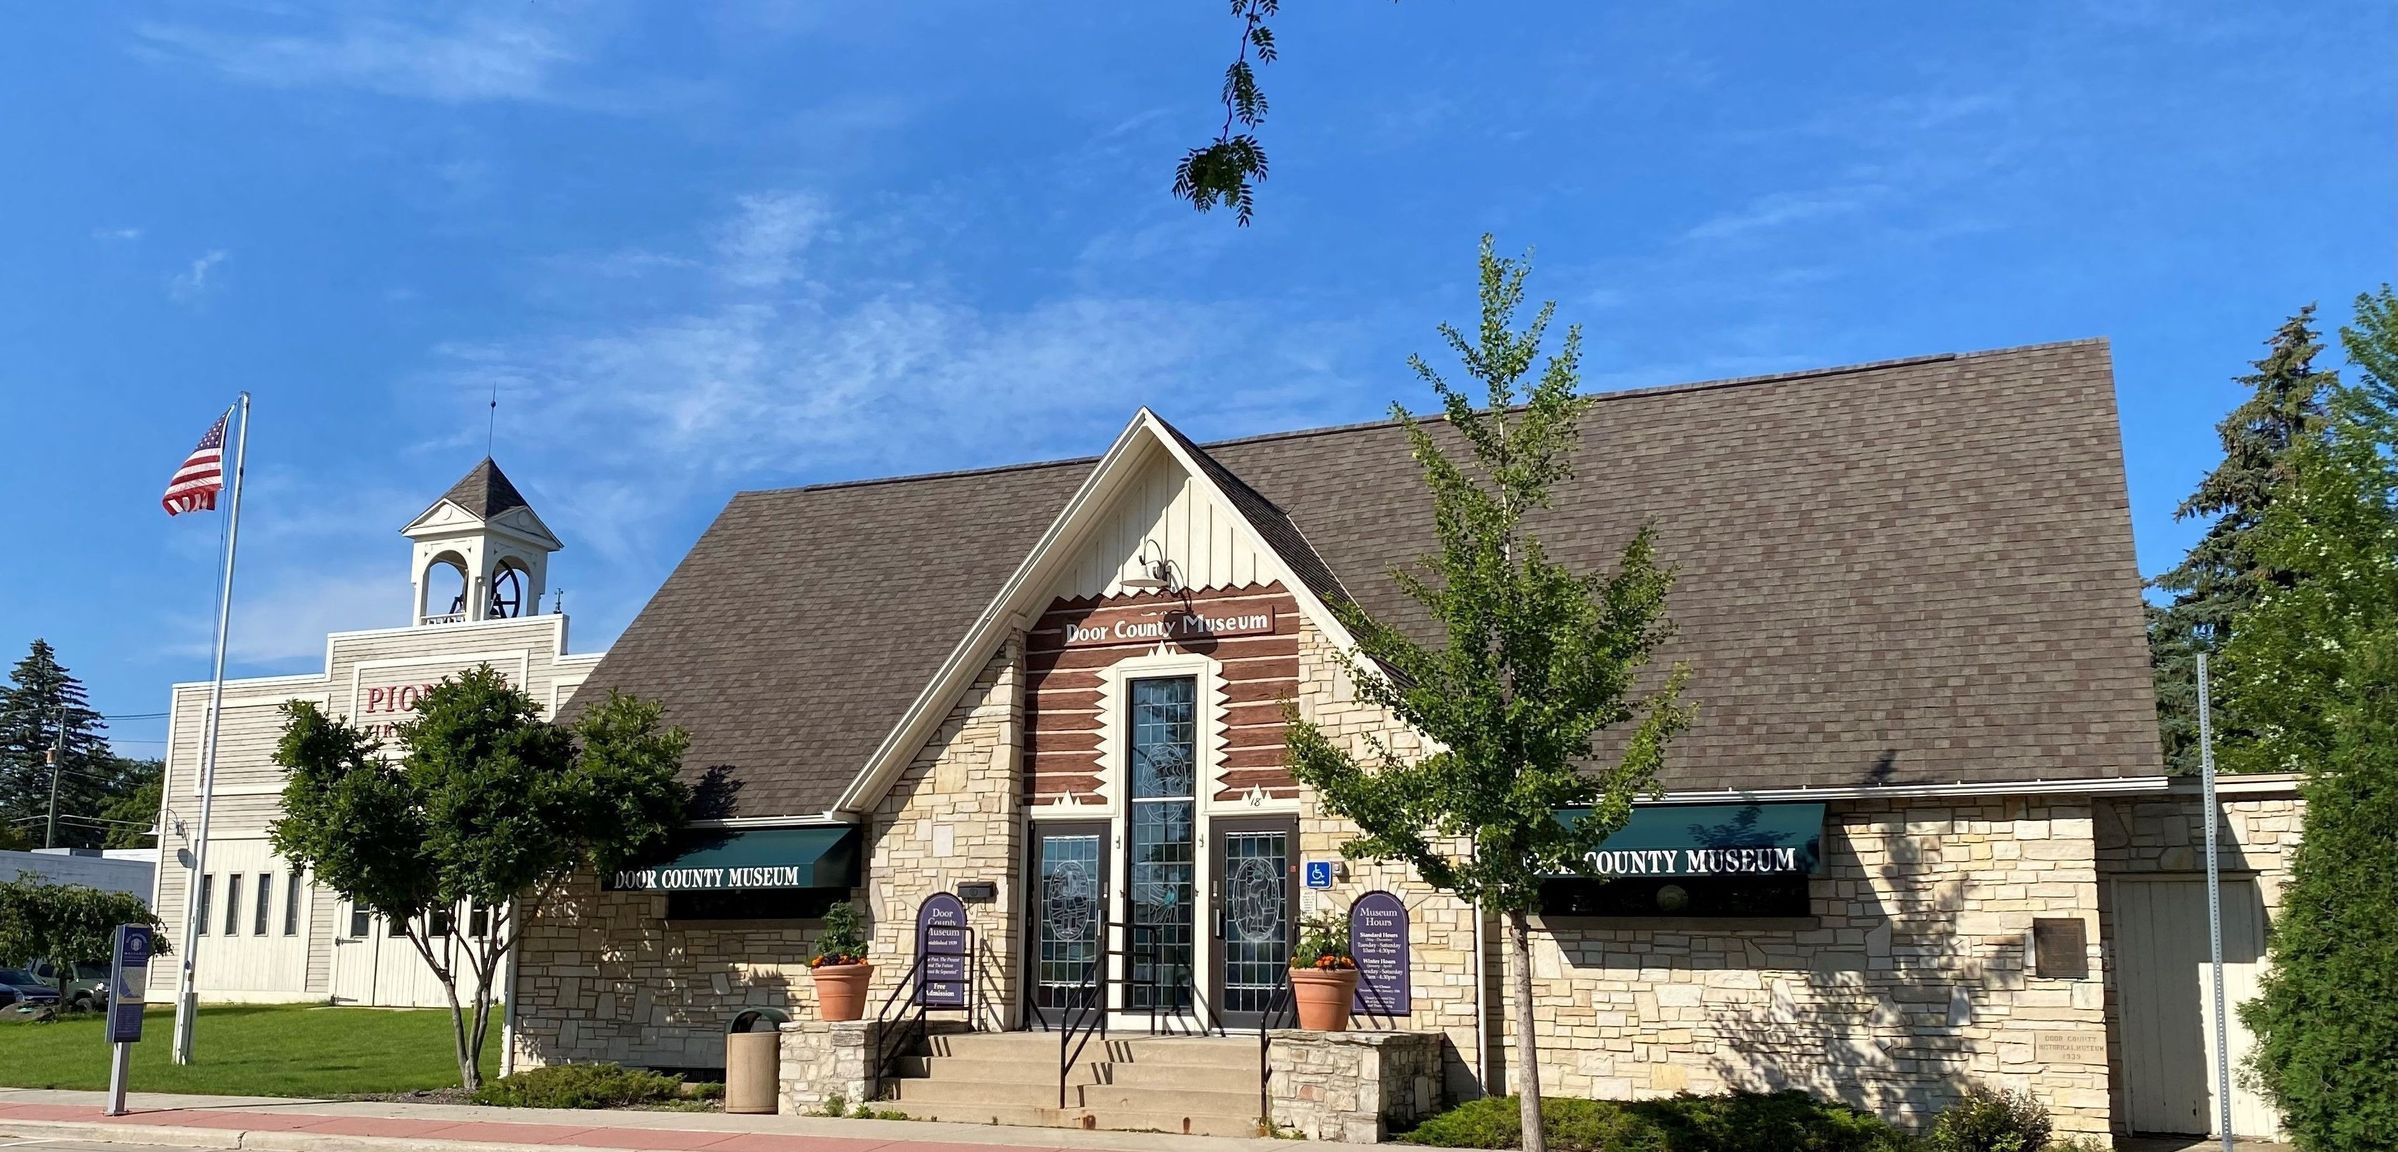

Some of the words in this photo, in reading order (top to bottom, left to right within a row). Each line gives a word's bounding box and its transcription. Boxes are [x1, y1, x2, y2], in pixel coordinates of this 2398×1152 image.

[1066, 623, 1109, 643] Door
[1114, 620, 1176, 638] County
[1182, 613, 1268, 634] Museum
[1250, 797, 1262, 807] 18
[1685, 847, 1797, 873] MUSEUM
[614, 870, 657, 889] DOOR
[661, 868, 724, 888] COUNTY
[728, 866, 799, 887] MUSEUM
[933, 908, 953, 917] Door
[1360, 907, 1397, 917] Museum
[1366, 917, 1392, 926] Hours
